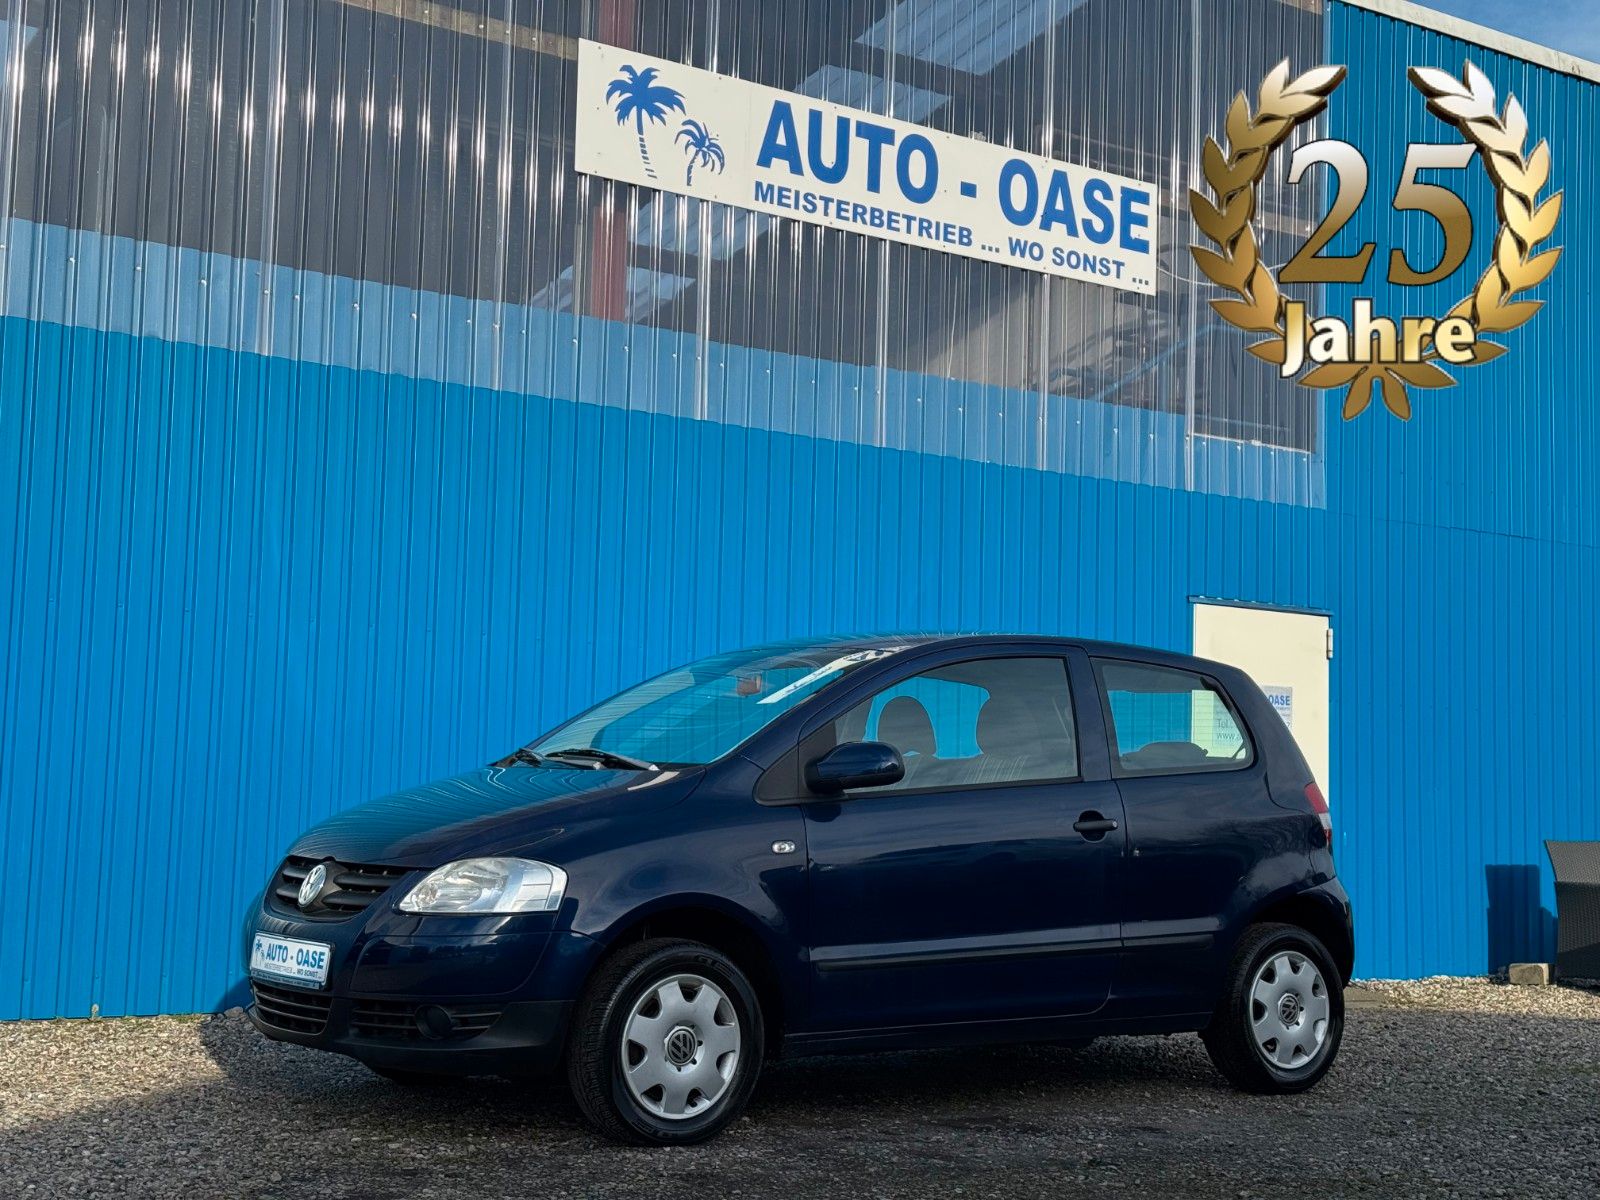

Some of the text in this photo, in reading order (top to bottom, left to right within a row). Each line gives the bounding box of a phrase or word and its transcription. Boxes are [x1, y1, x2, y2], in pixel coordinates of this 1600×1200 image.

[756, 99, 939, 204] AUTO
[999, 158, 1150, 254] OASE
[754, 180, 973, 247] MEISTERBETRIEB
[1008, 236, 1044, 262] WO
[1051, 246, 1126, 280] SONST
[266, 943, 289, 963] AUTO
[296, 948, 325, 969] OASE
